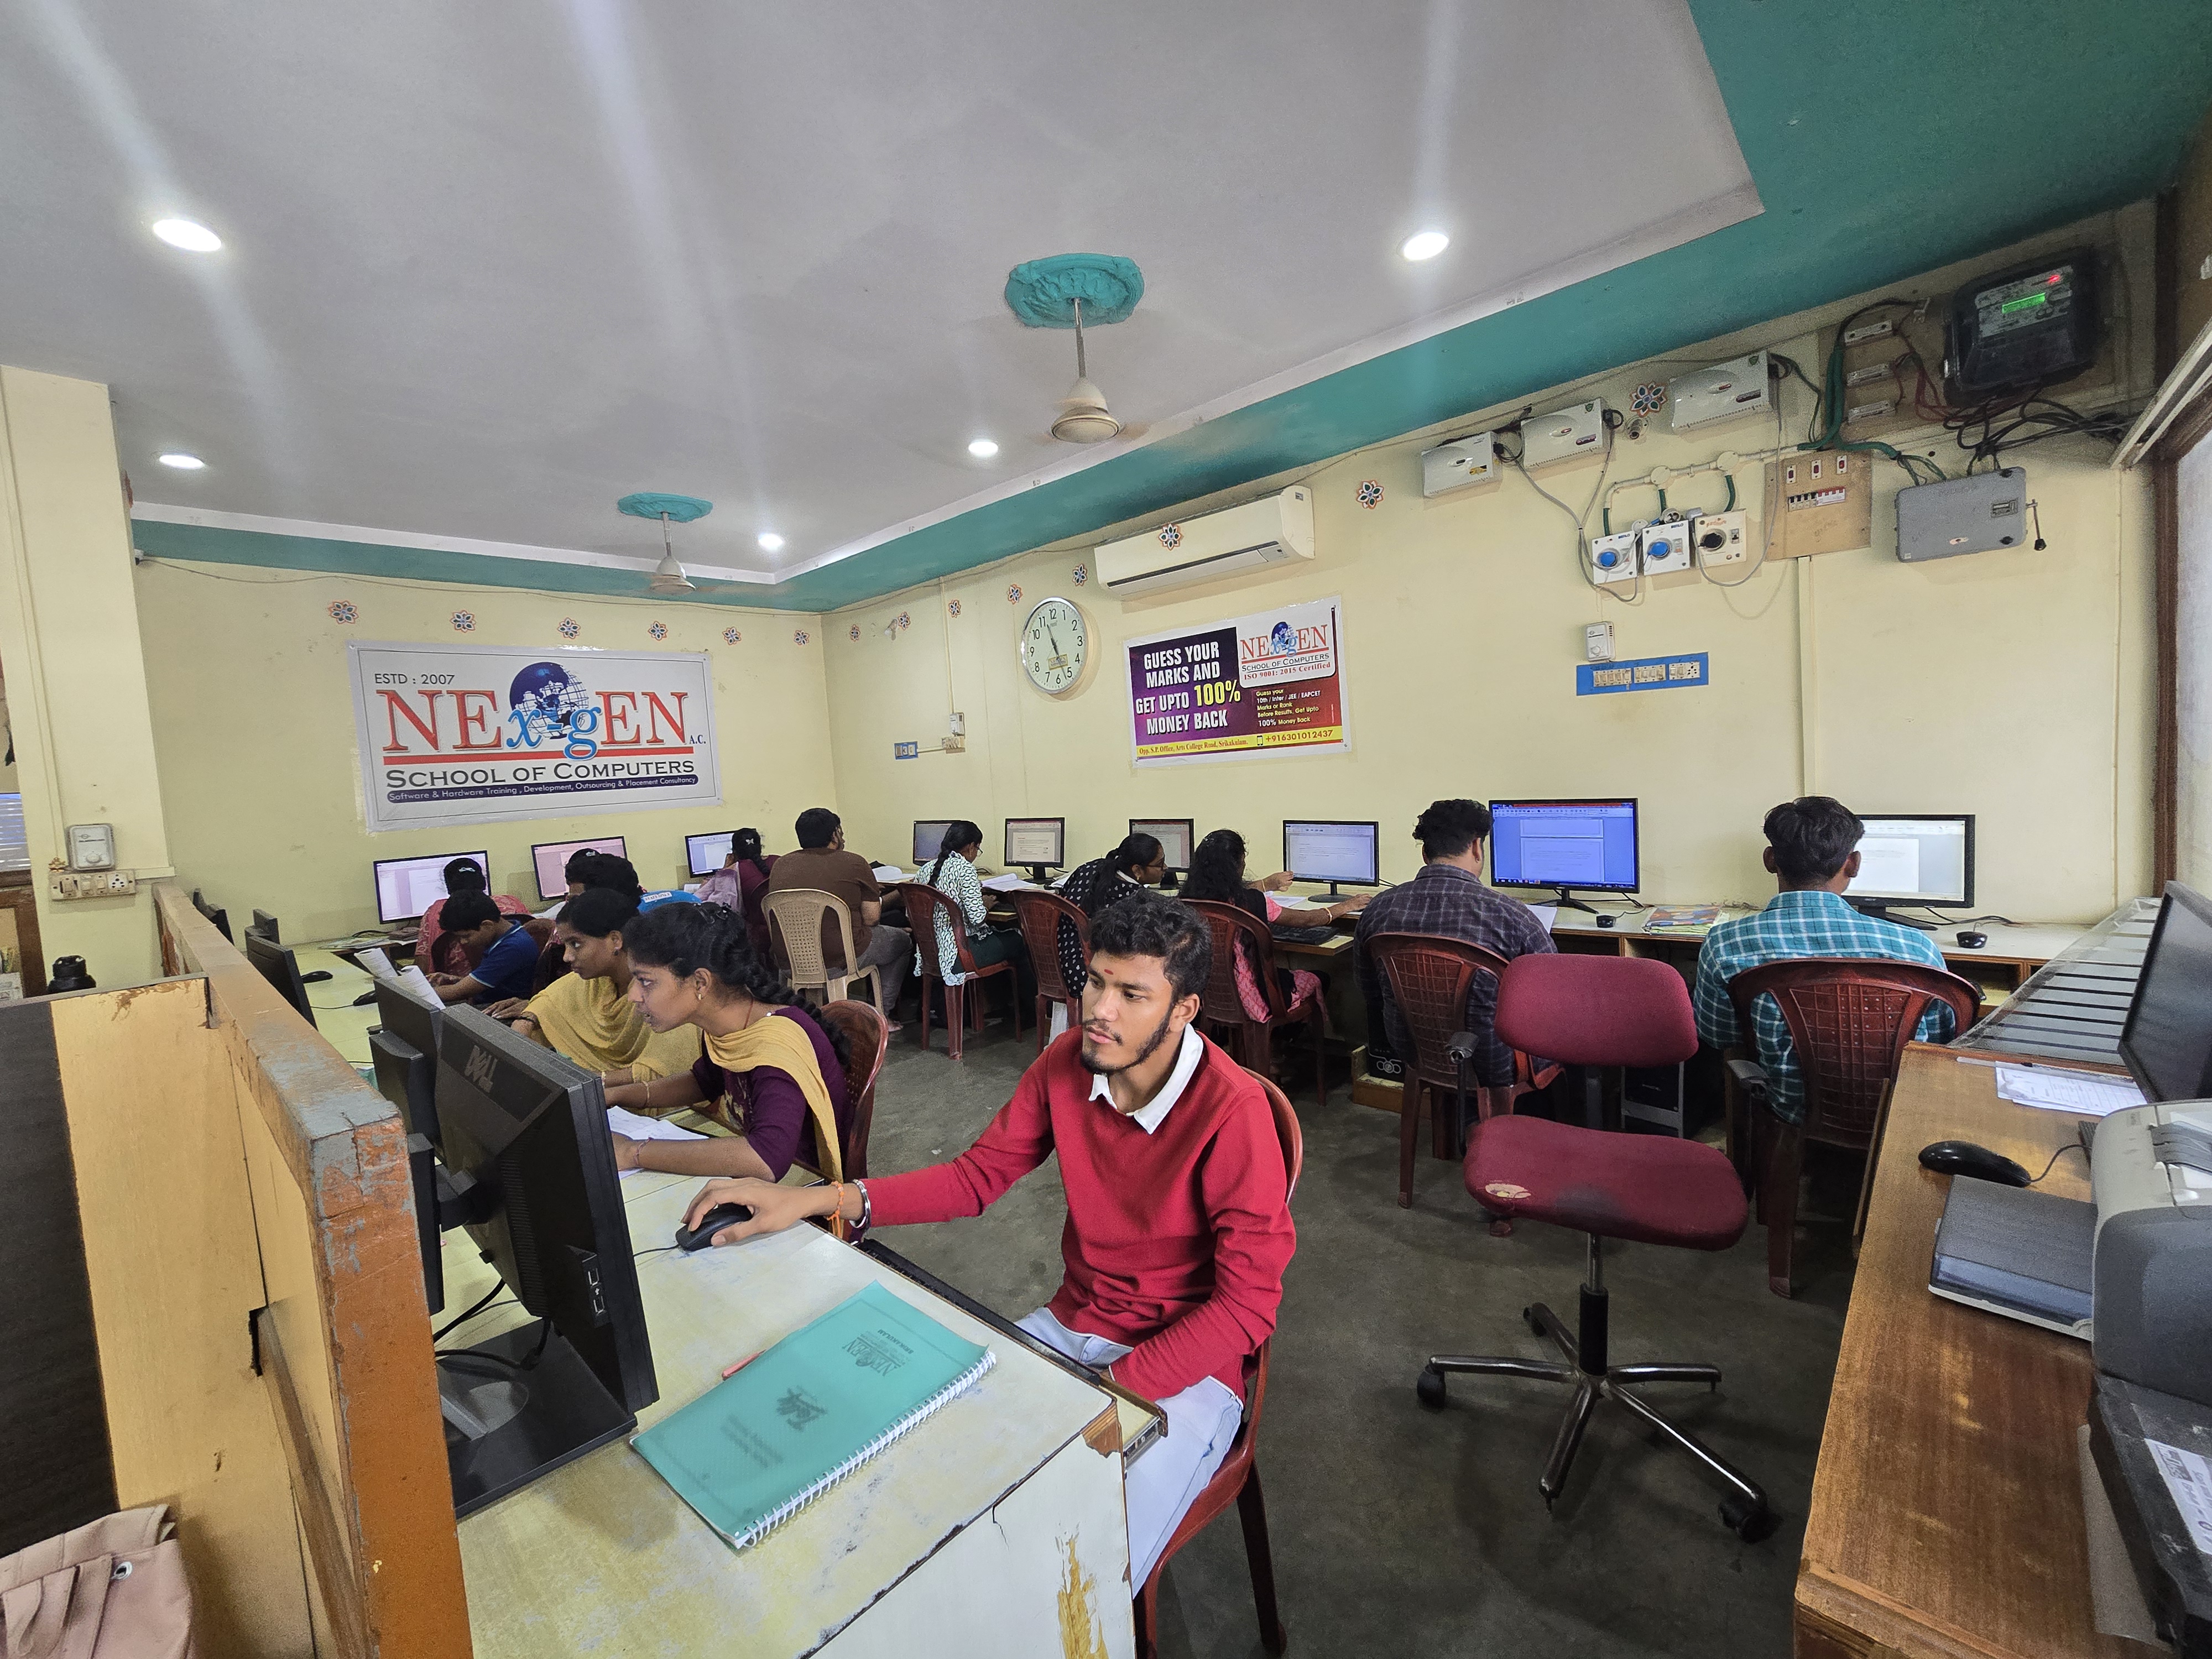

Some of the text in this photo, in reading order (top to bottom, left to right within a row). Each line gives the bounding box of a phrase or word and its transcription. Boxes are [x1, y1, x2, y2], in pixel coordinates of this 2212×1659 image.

[1049, 608, 1057, 620] 12
[1062, 610, 1066, 620] 1
[1039, 617, 1046, 628] 11
[1072, 620, 1077, 631] 2
[1032, 629, 1040, 640] 10
[1077, 636, 1083, 646] 3
[1030, 646, 1034, 657] 9
[1144, 641, 1219, 670] GUESS YOUR
[1075, 653, 1080, 664] 4
[1242, 663, 1270, 672] SCHOOL
[1283, 653, 1329, 665] COMPUTERS
[1035, 662, 1040, 672] 8
[1067, 667, 1072, 678] 5
[1299, 662, 1331, 672] Certified
[374, 673, 408, 684] ESTD
[421, 674, 455, 685] 2007
[1045, 671, 1050, 682] 7
[1056, 674, 1061, 685] 6
[1146, 661, 1220, 688] MARKS AND
[1136, 680, 1241, 714] GET UPTO 100%
[1146, 709, 1228, 734] MONEY BACK
[690, 735, 707, 744] A.C.
[1266, 729, 1333, 742] +916301012437
[1186, 742, 1203, 750] College
[387, 760, 695, 788] SCHOOL OF COMPUTERS
[389, 792, 429, 801] Software
[442, 788, 484, 797] Hardware
[487, 787, 517, 796] Training
[524, 784, 574, 793] Development,
[575, 781, 615, 790] Outsourcing
[626, 778, 658, 786] Placement
[660, 776, 696, 785] Consultancy
[462, 1045, 498, 1093] DELL
[878, 1329, 914, 1354] SRIKAKULAM
